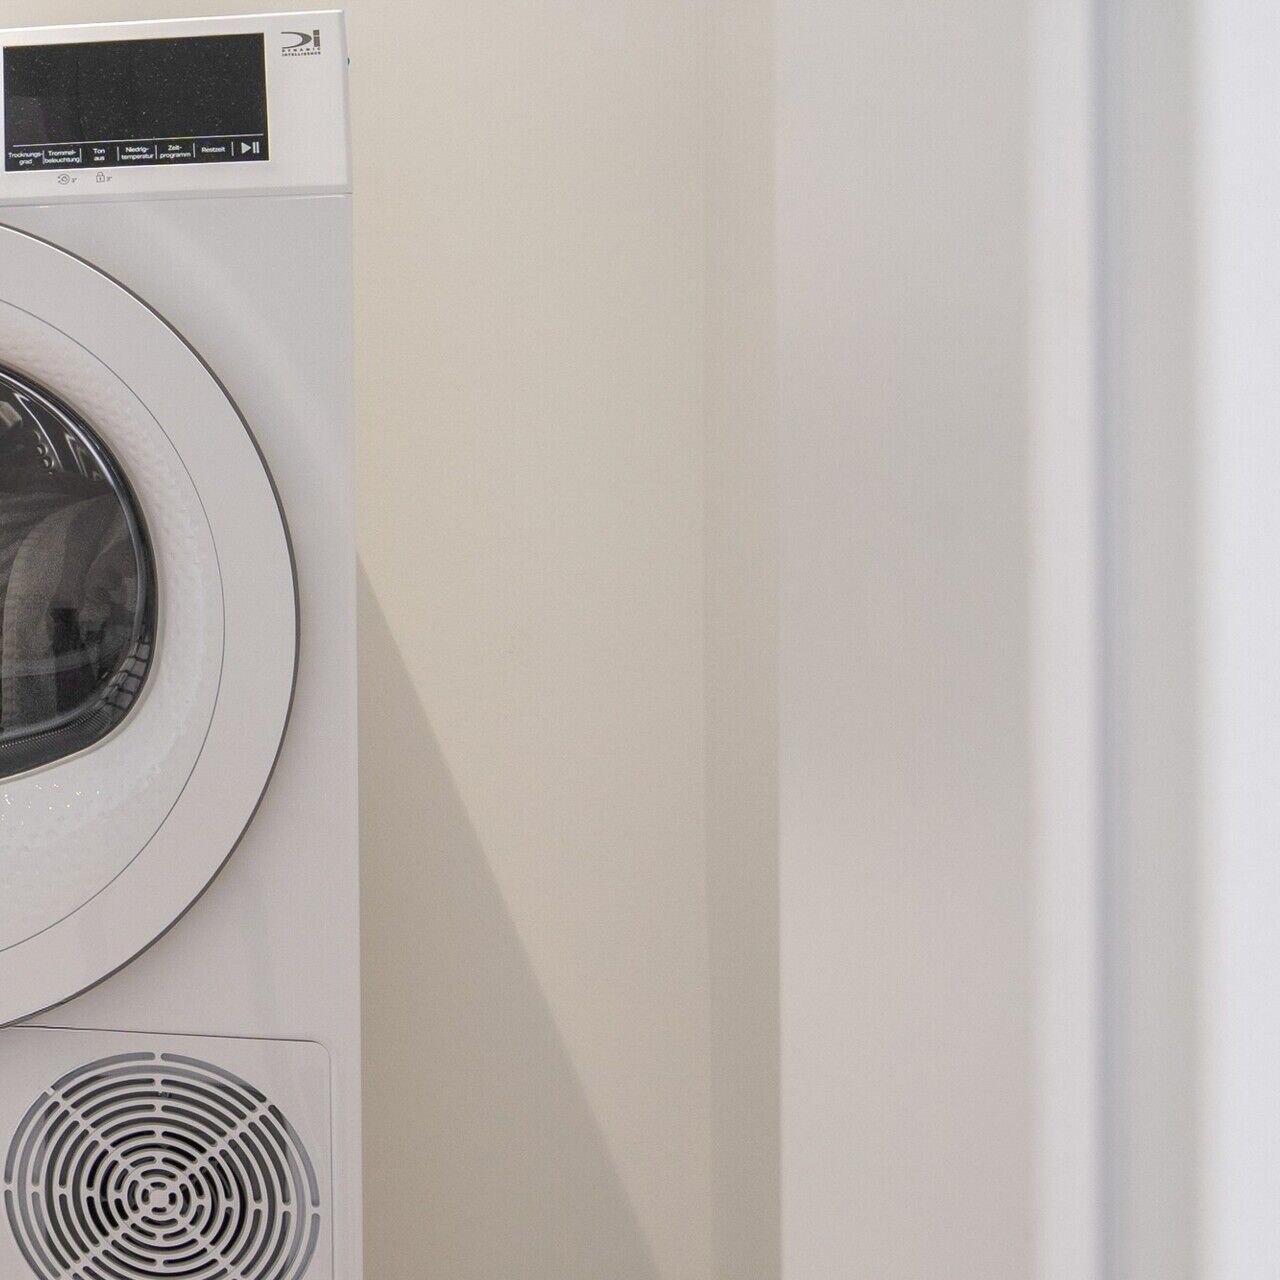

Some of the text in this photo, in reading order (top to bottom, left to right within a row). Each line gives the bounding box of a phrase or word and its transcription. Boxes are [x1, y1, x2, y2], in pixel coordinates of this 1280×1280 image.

[47, 149, 76, 157] Trommel-
[125, 146, 149, 154] Niedrig-
[121, 153, 154, 161] temperatur
[159, 151, 192, 159] programm
